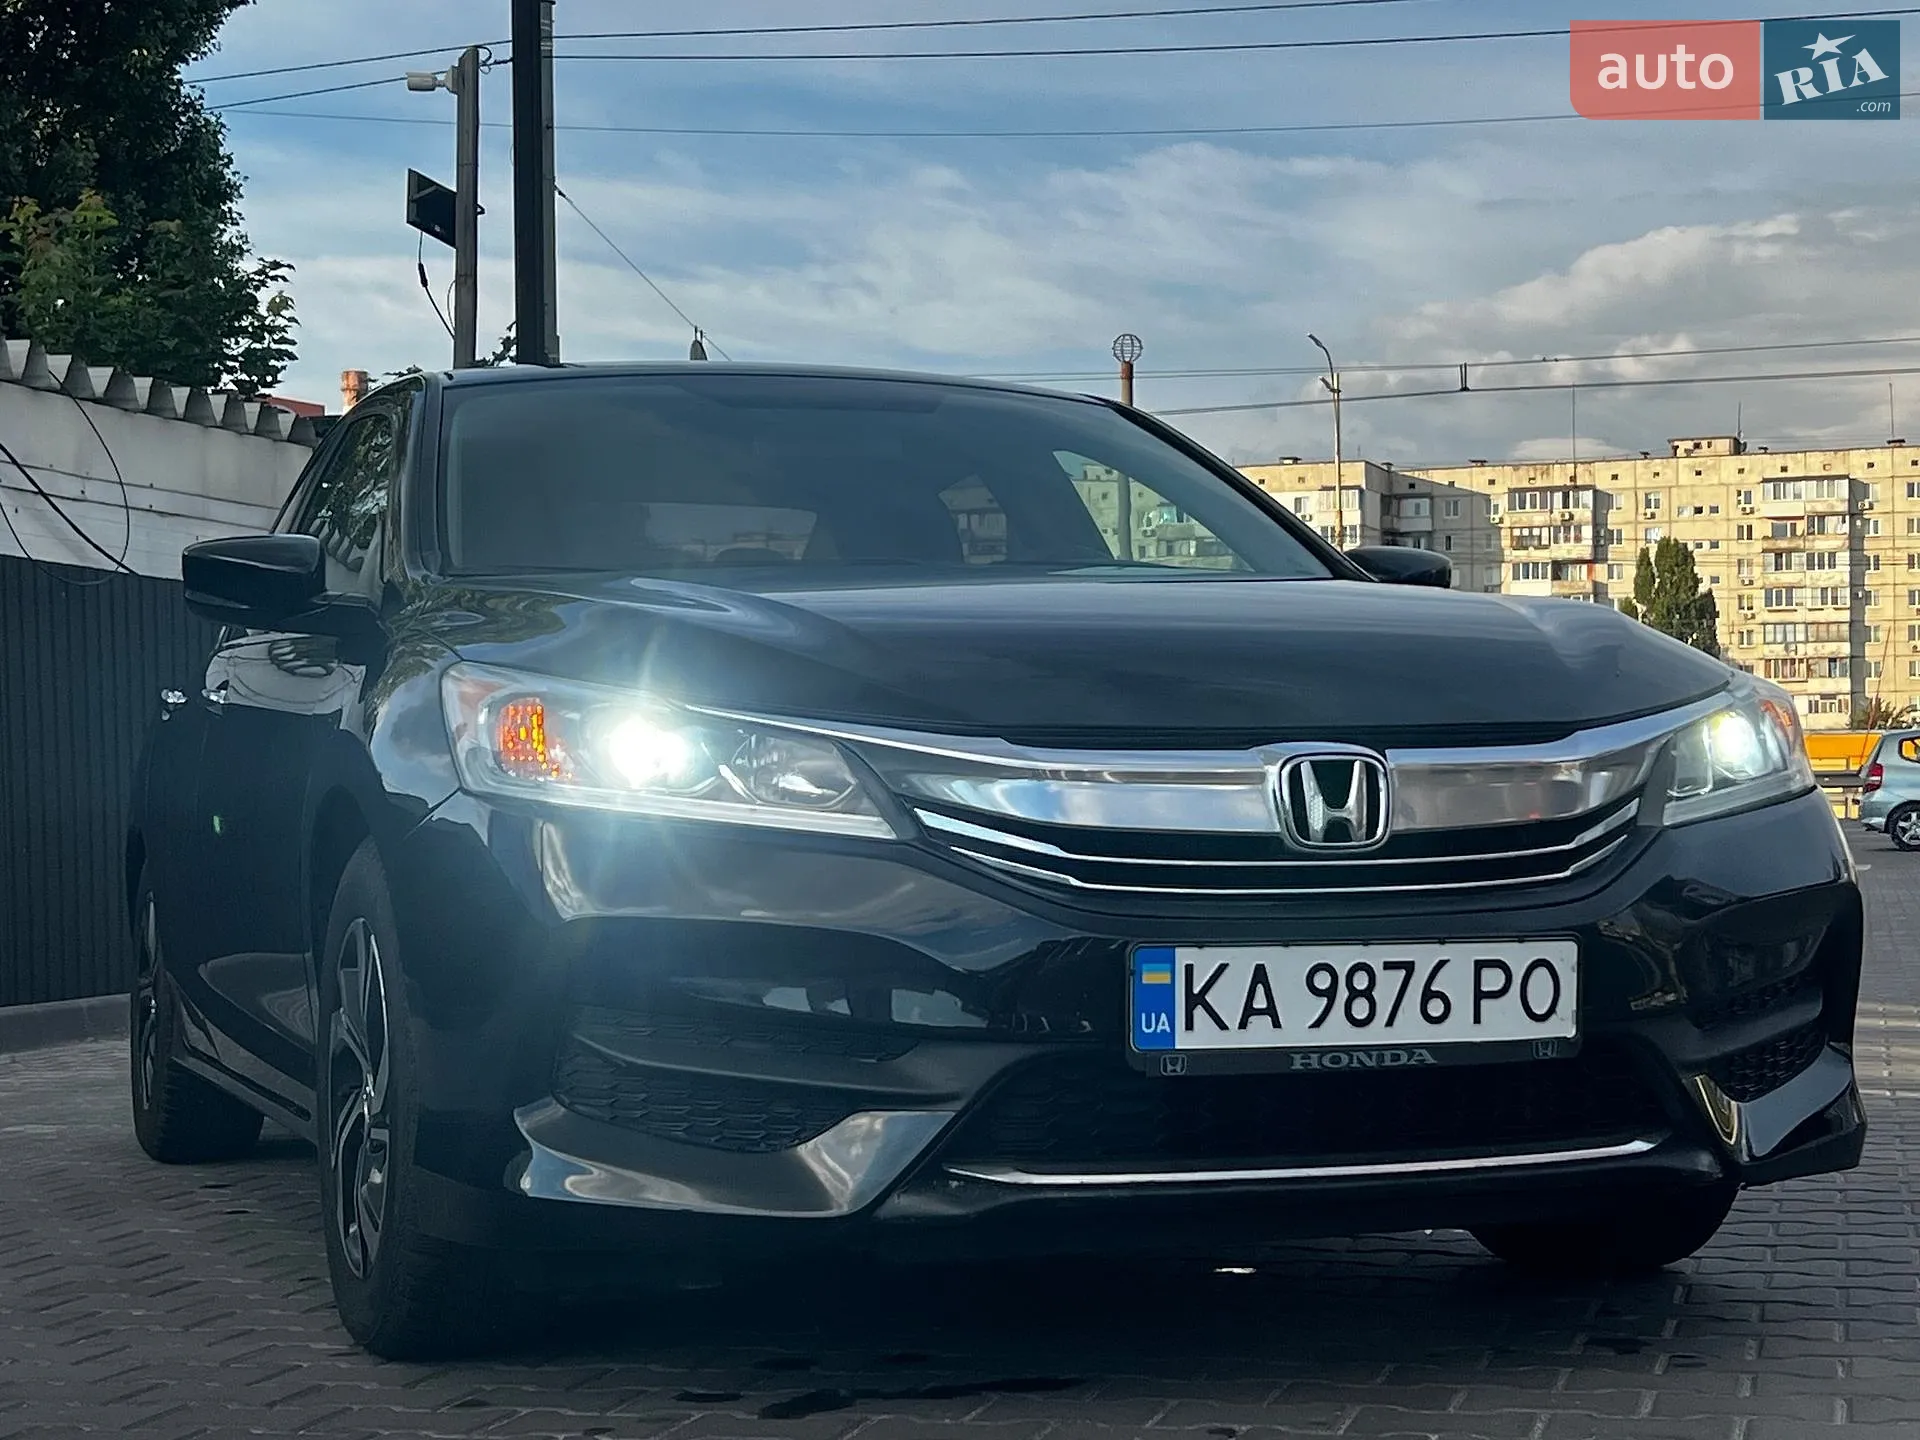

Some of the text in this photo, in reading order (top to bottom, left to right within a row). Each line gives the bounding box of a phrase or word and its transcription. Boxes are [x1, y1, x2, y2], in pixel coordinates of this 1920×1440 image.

[1183, 958, 1561, 1032] KA 9876 PO
[1141, 1012, 1171, 1034] UA
[1290, 1048, 1438, 1071] HONDA
